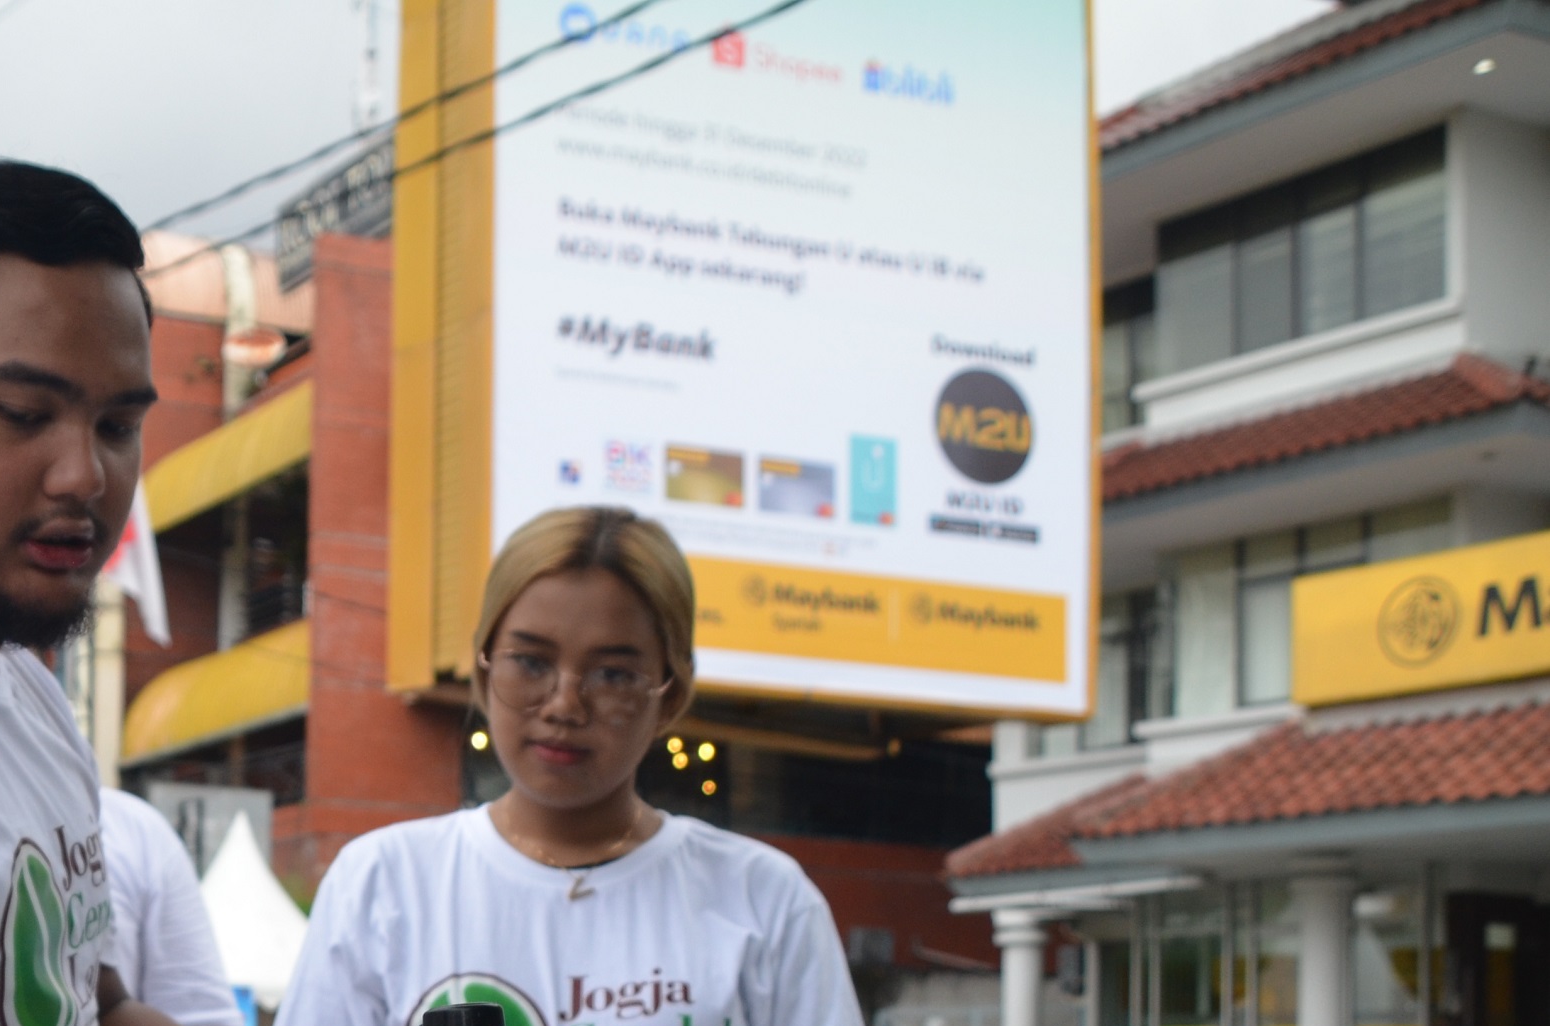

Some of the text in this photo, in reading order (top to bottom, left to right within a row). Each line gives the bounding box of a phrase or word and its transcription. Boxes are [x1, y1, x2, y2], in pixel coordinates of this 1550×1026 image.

[557, 196, 617, 224] Buka
[621, 205, 722, 241] Maybank
[728, 221, 831, 259] Tabungan
[858, 246, 903, 271] atau
[557, 234, 613, 262] M2U
[618, 243, 645, 267] ID
[651, 248, 693, 277] App
[557, 312, 716, 361] #MyBank
[931, 333, 1037, 367] Download
[938, 402, 1034, 454] M2U
[773, 582, 880, 617] Maybank
[938, 601, 1041, 633] Maybank
[1477, 573, 1550, 639] M
[54, 815, 107, 892] Jog
[67, 891, 115, 950] Cen
[558, 967, 695, 1023] Jogja
